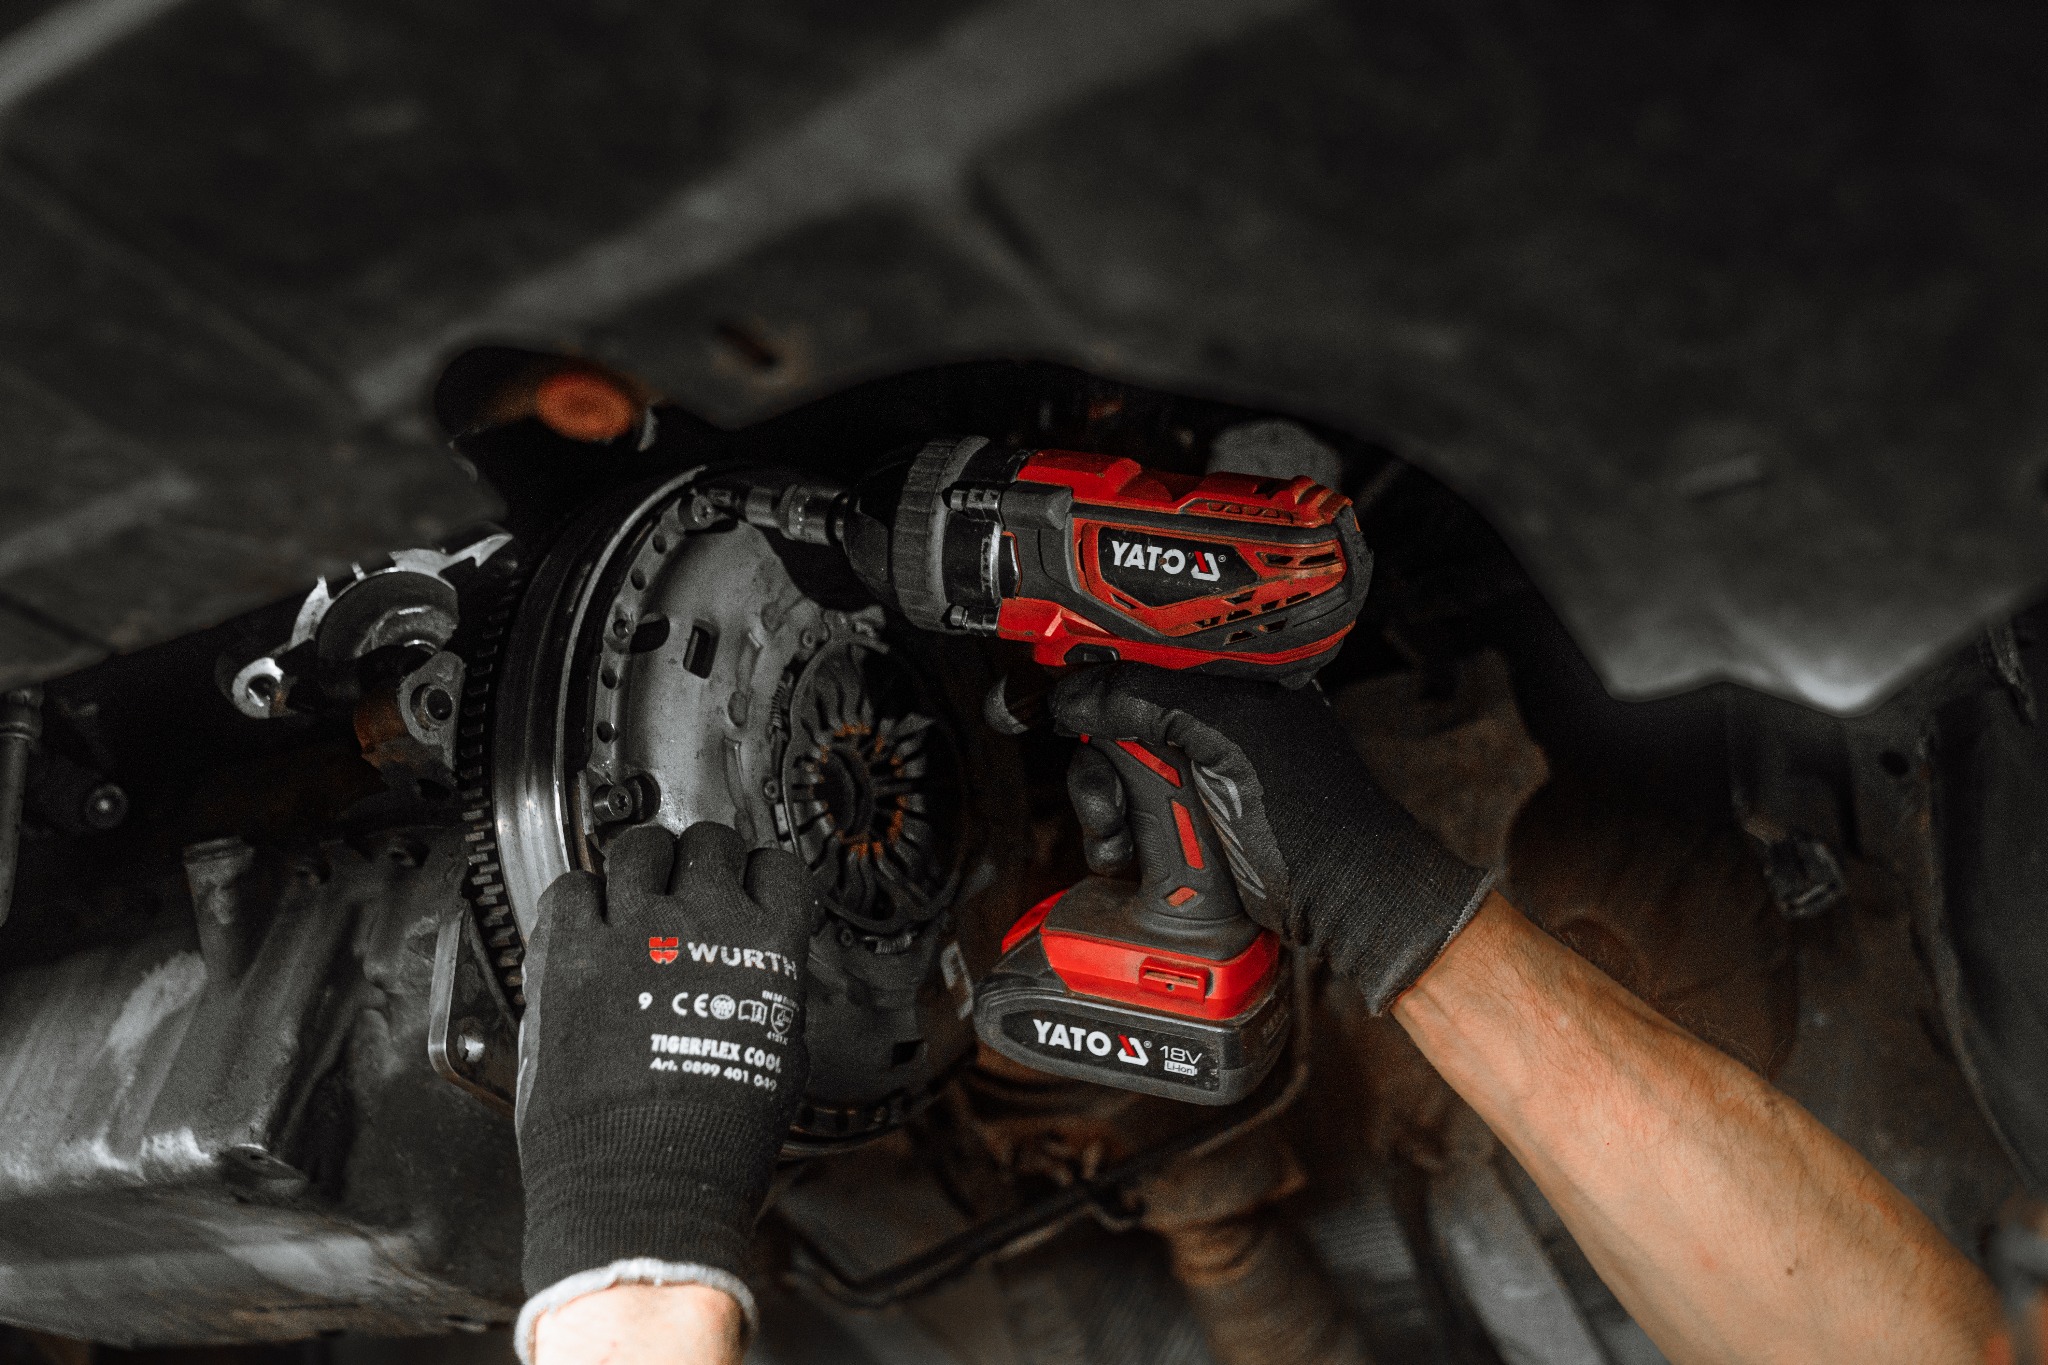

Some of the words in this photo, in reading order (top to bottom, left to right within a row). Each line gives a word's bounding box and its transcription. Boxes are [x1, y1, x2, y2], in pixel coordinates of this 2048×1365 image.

[1111, 540, 1186, 575] YATO
[638, 992, 653, 1010] 9
[672, 992, 709, 1018] CE
[651, 1034, 740, 1061] TIGERFLEX
[1032, 1019, 1112, 1057] YATO
[1160, 1045, 1203, 1065] 18V
[650, 1057, 678, 1071] Art.
[682, 1060, 720, 1077] 0899
[723, 1066, 749, 1084] 401
